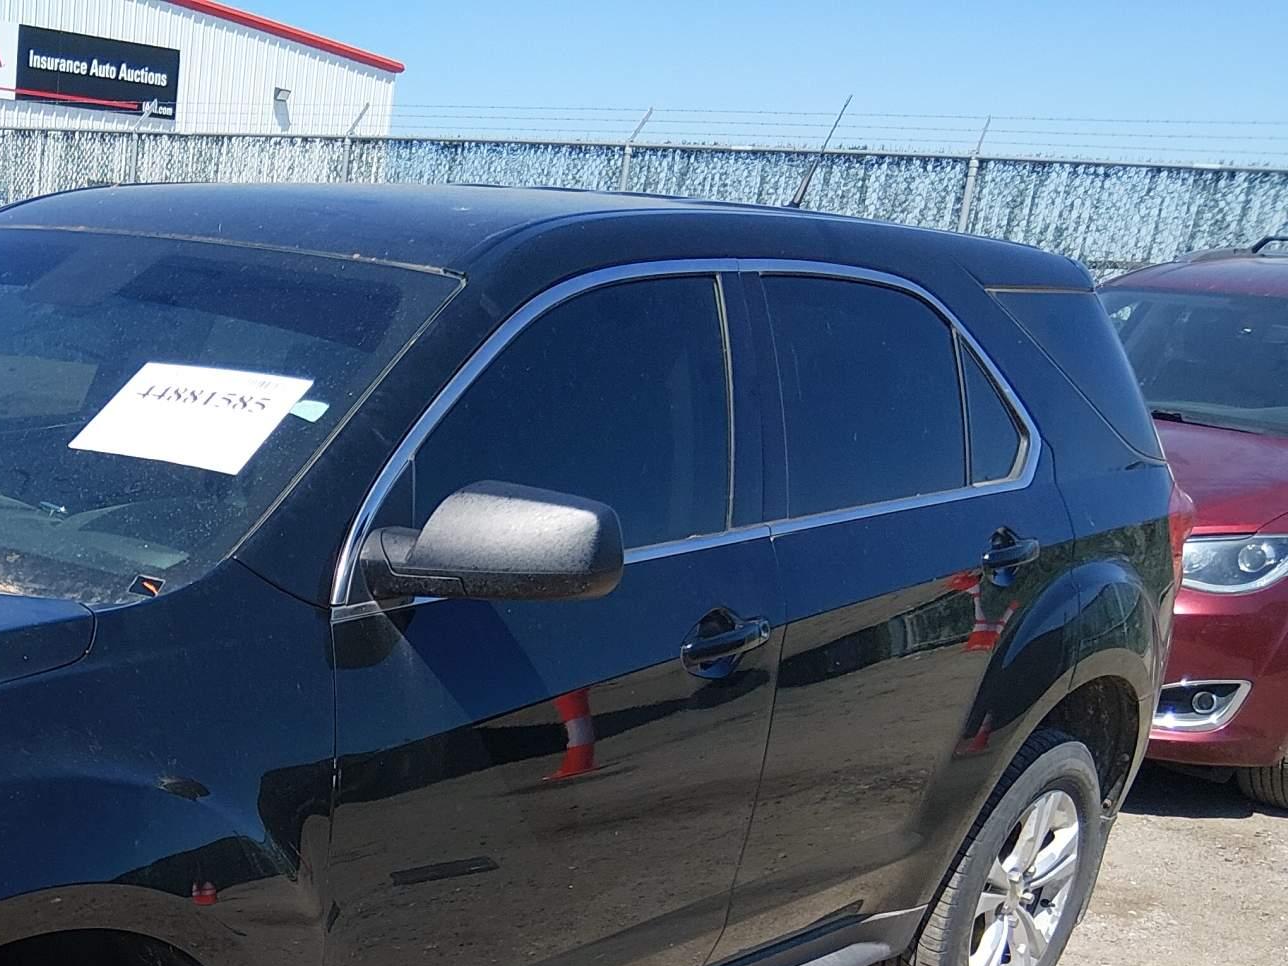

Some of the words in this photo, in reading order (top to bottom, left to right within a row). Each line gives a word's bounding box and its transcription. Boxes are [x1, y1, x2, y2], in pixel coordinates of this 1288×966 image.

[28, 49, 88, 75] Insurance
[89, 58, 117, 79] Auto
[118, 62, 168, 87] Auctions
[135, 384, 272, 413] 44881585
